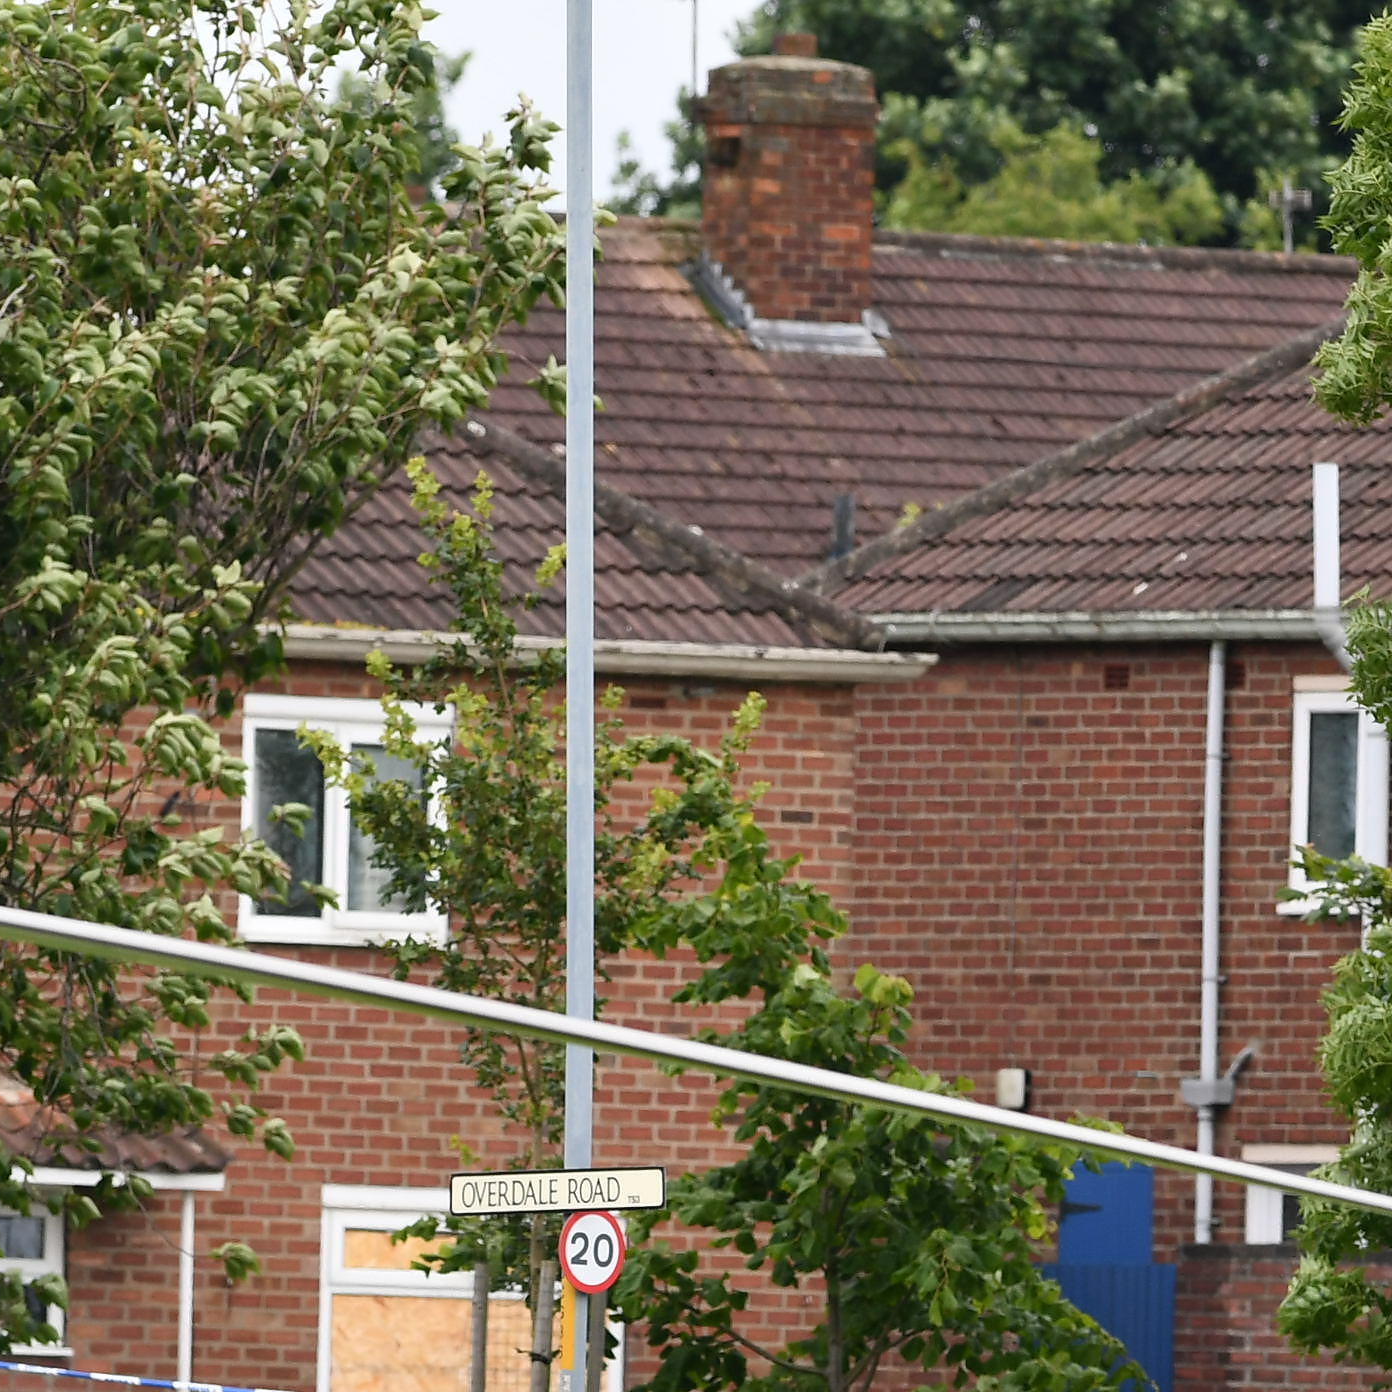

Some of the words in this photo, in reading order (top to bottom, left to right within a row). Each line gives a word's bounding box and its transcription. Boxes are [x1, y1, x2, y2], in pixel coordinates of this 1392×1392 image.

[462, 1179, 558, 1208] OVERDALE
[567, 1176, 621, 1204] ROAD
[570, 1231, 614, 1268] 20
